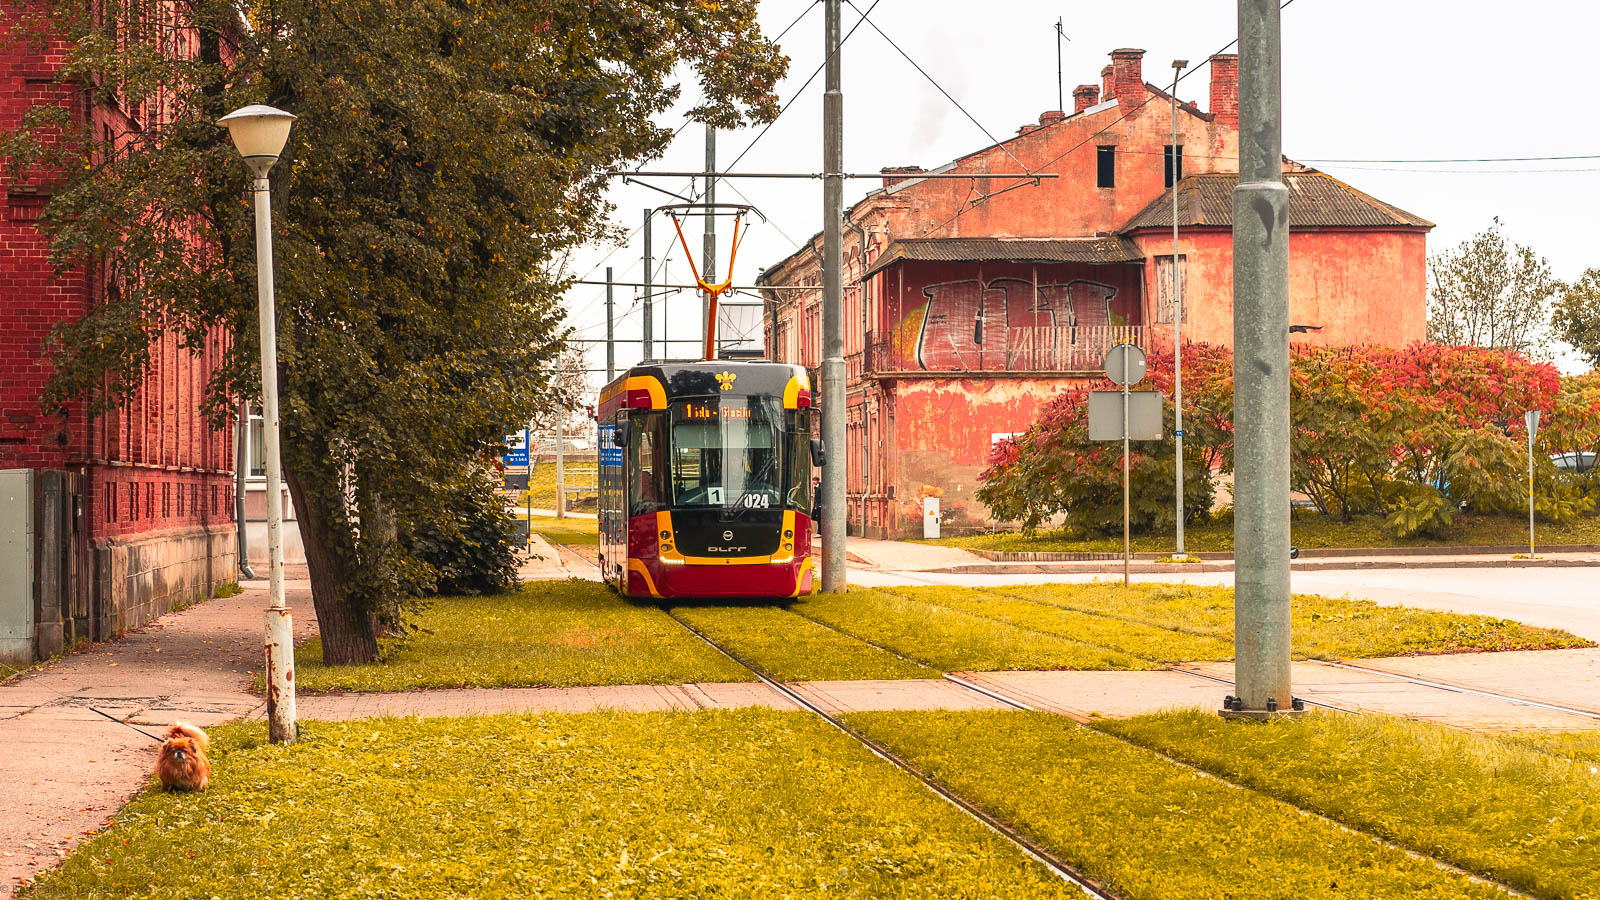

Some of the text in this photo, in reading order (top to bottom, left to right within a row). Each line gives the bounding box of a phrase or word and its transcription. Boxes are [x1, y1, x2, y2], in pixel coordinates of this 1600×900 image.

[687, 403, 692, 418] 1
[711, 489, 720, 502] 1
[743, 493, 769, 509] 024
